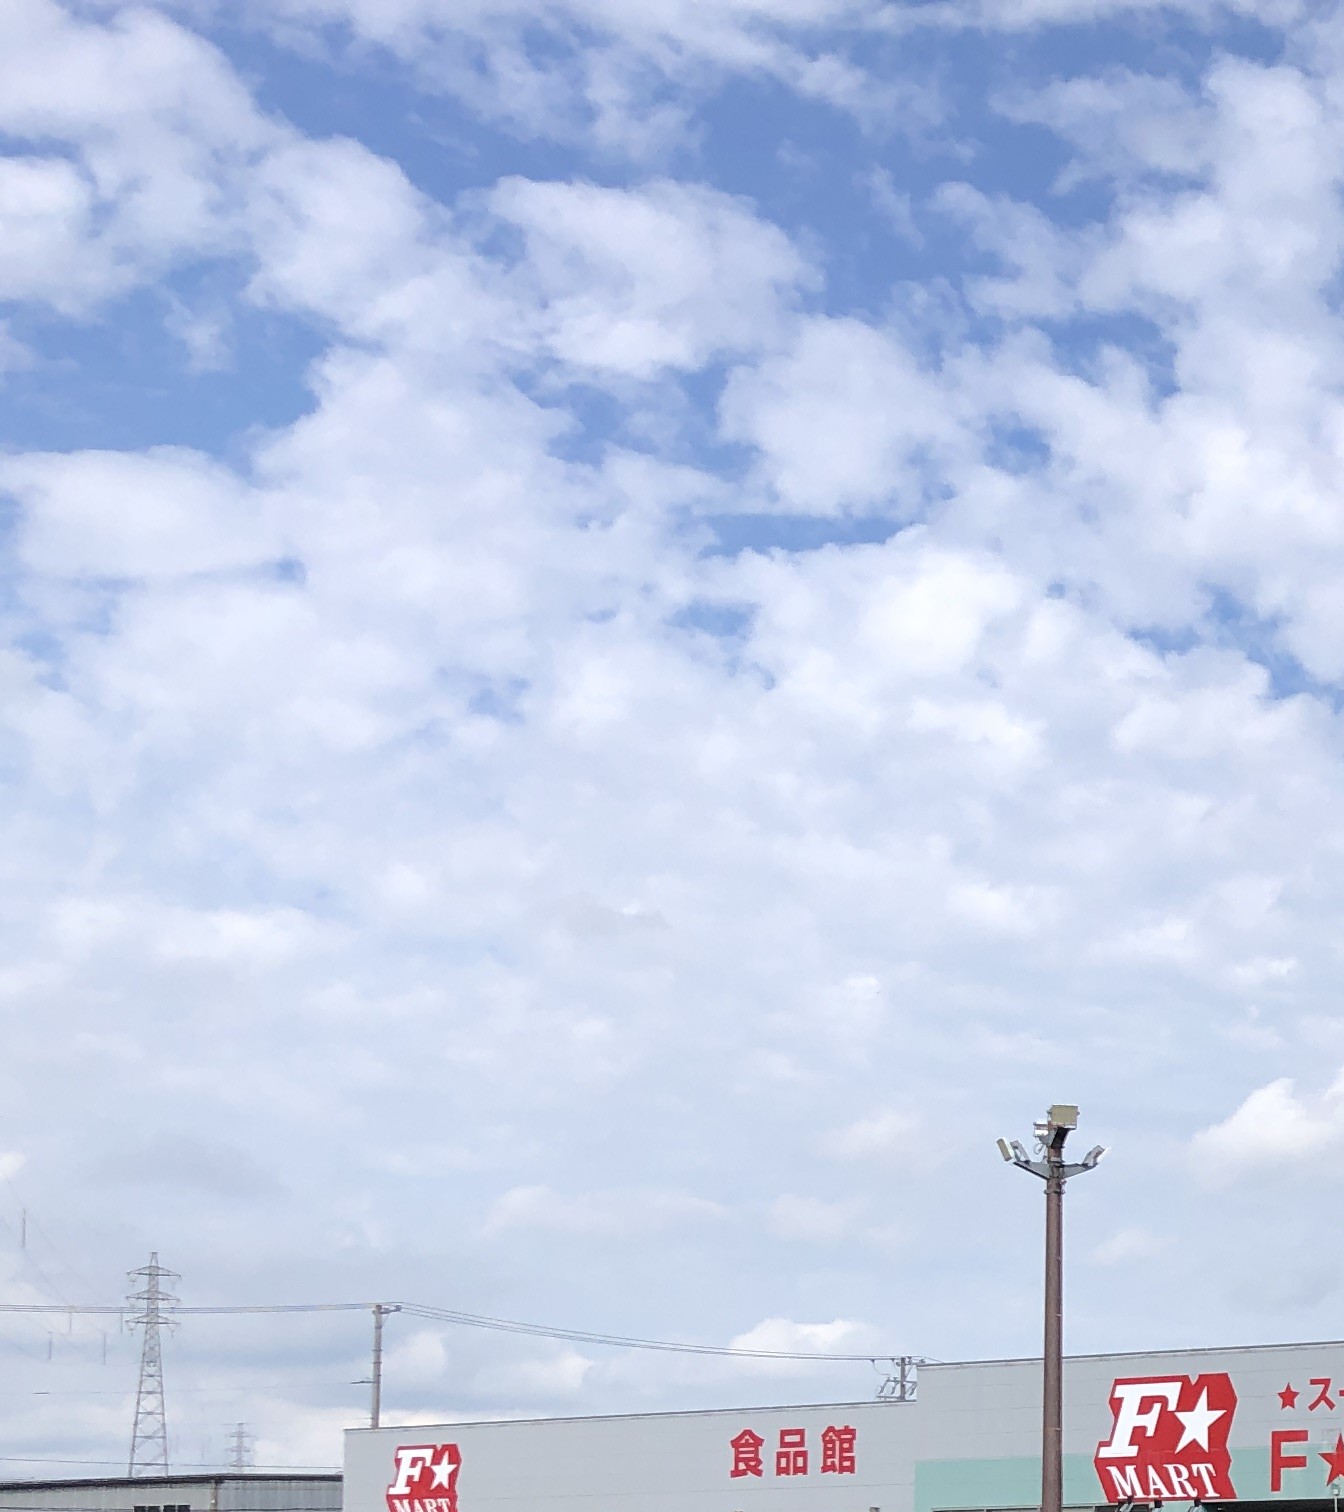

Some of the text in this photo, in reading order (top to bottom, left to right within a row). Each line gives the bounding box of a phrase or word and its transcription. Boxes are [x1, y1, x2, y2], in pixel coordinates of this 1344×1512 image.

[730, 1425, 857, 1478] 食品館
[1106, 1463, 1220, 1499] MART
